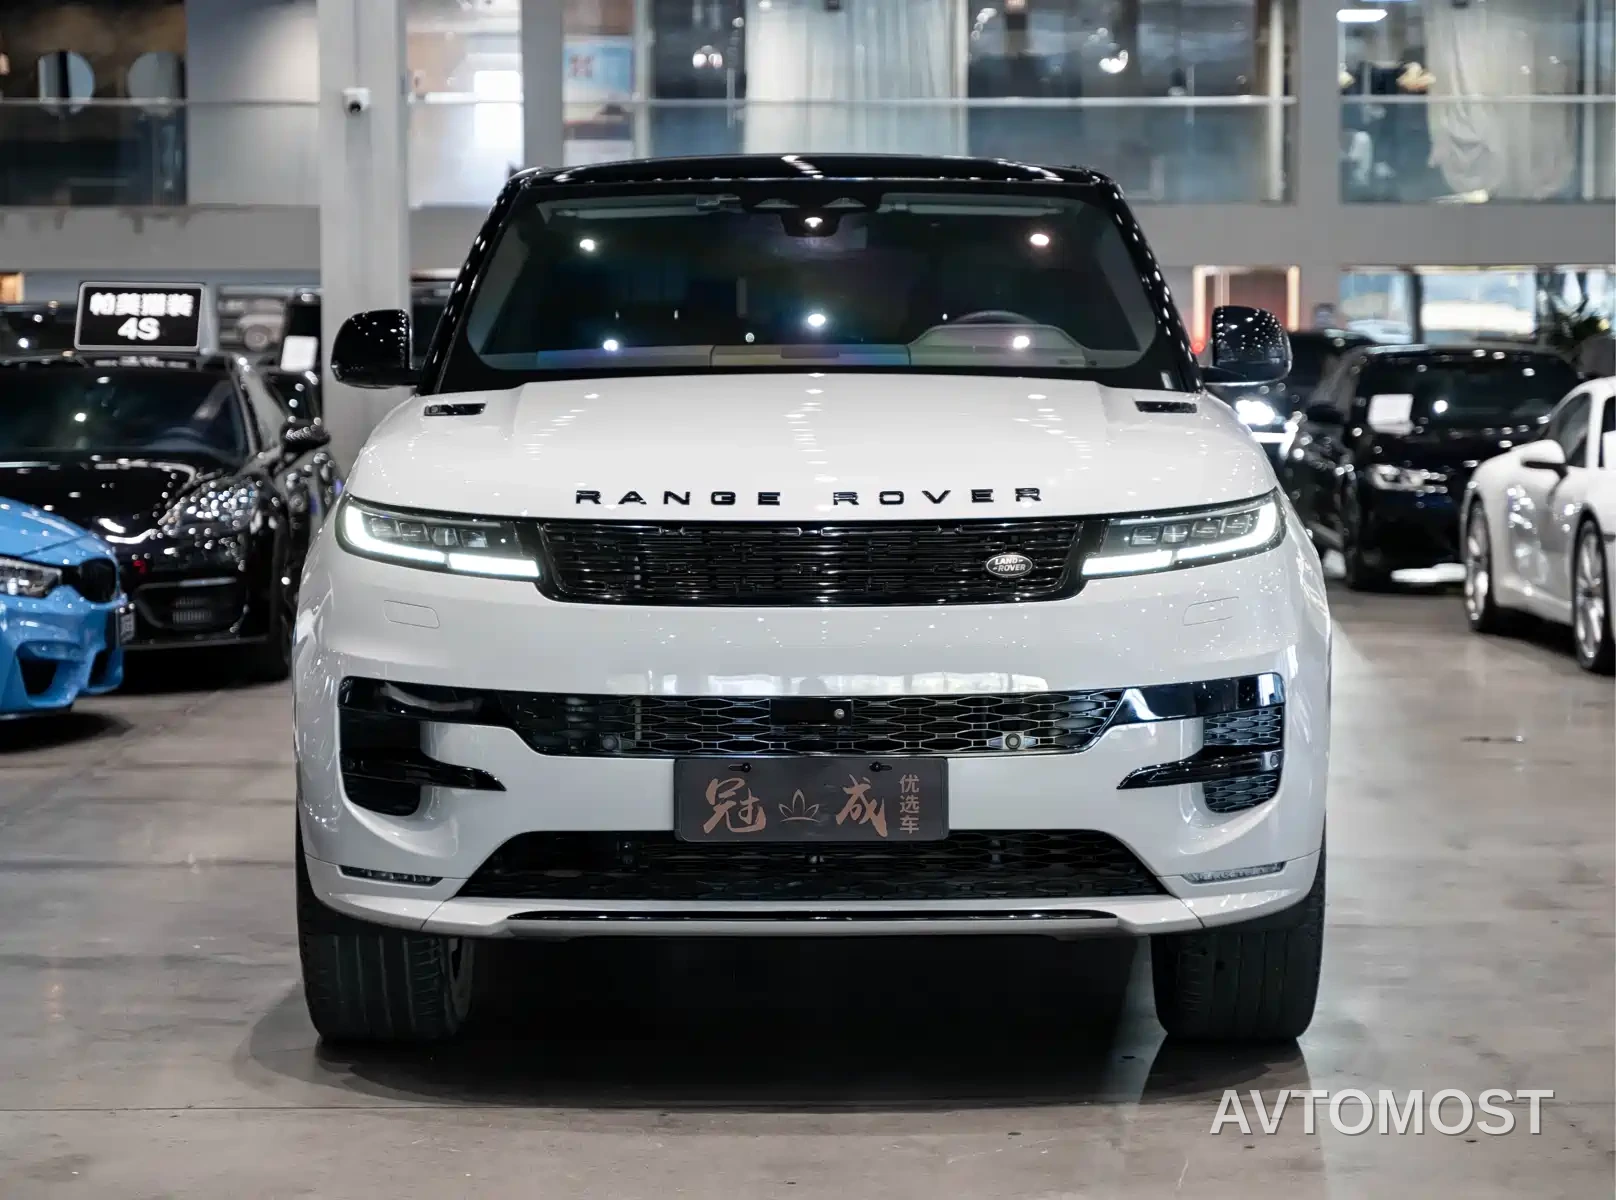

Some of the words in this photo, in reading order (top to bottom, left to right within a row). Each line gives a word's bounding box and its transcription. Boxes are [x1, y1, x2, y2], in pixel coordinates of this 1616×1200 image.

[117, 317, 160, 341] 4S
[575, 489, 782, 507] RANGE
[832, 487, 1043, 507] ROVER
[703, 777, 767, 834] 冠
[835, 774, 888, 837] 成
[899, 774, 920, 834] 优选车
